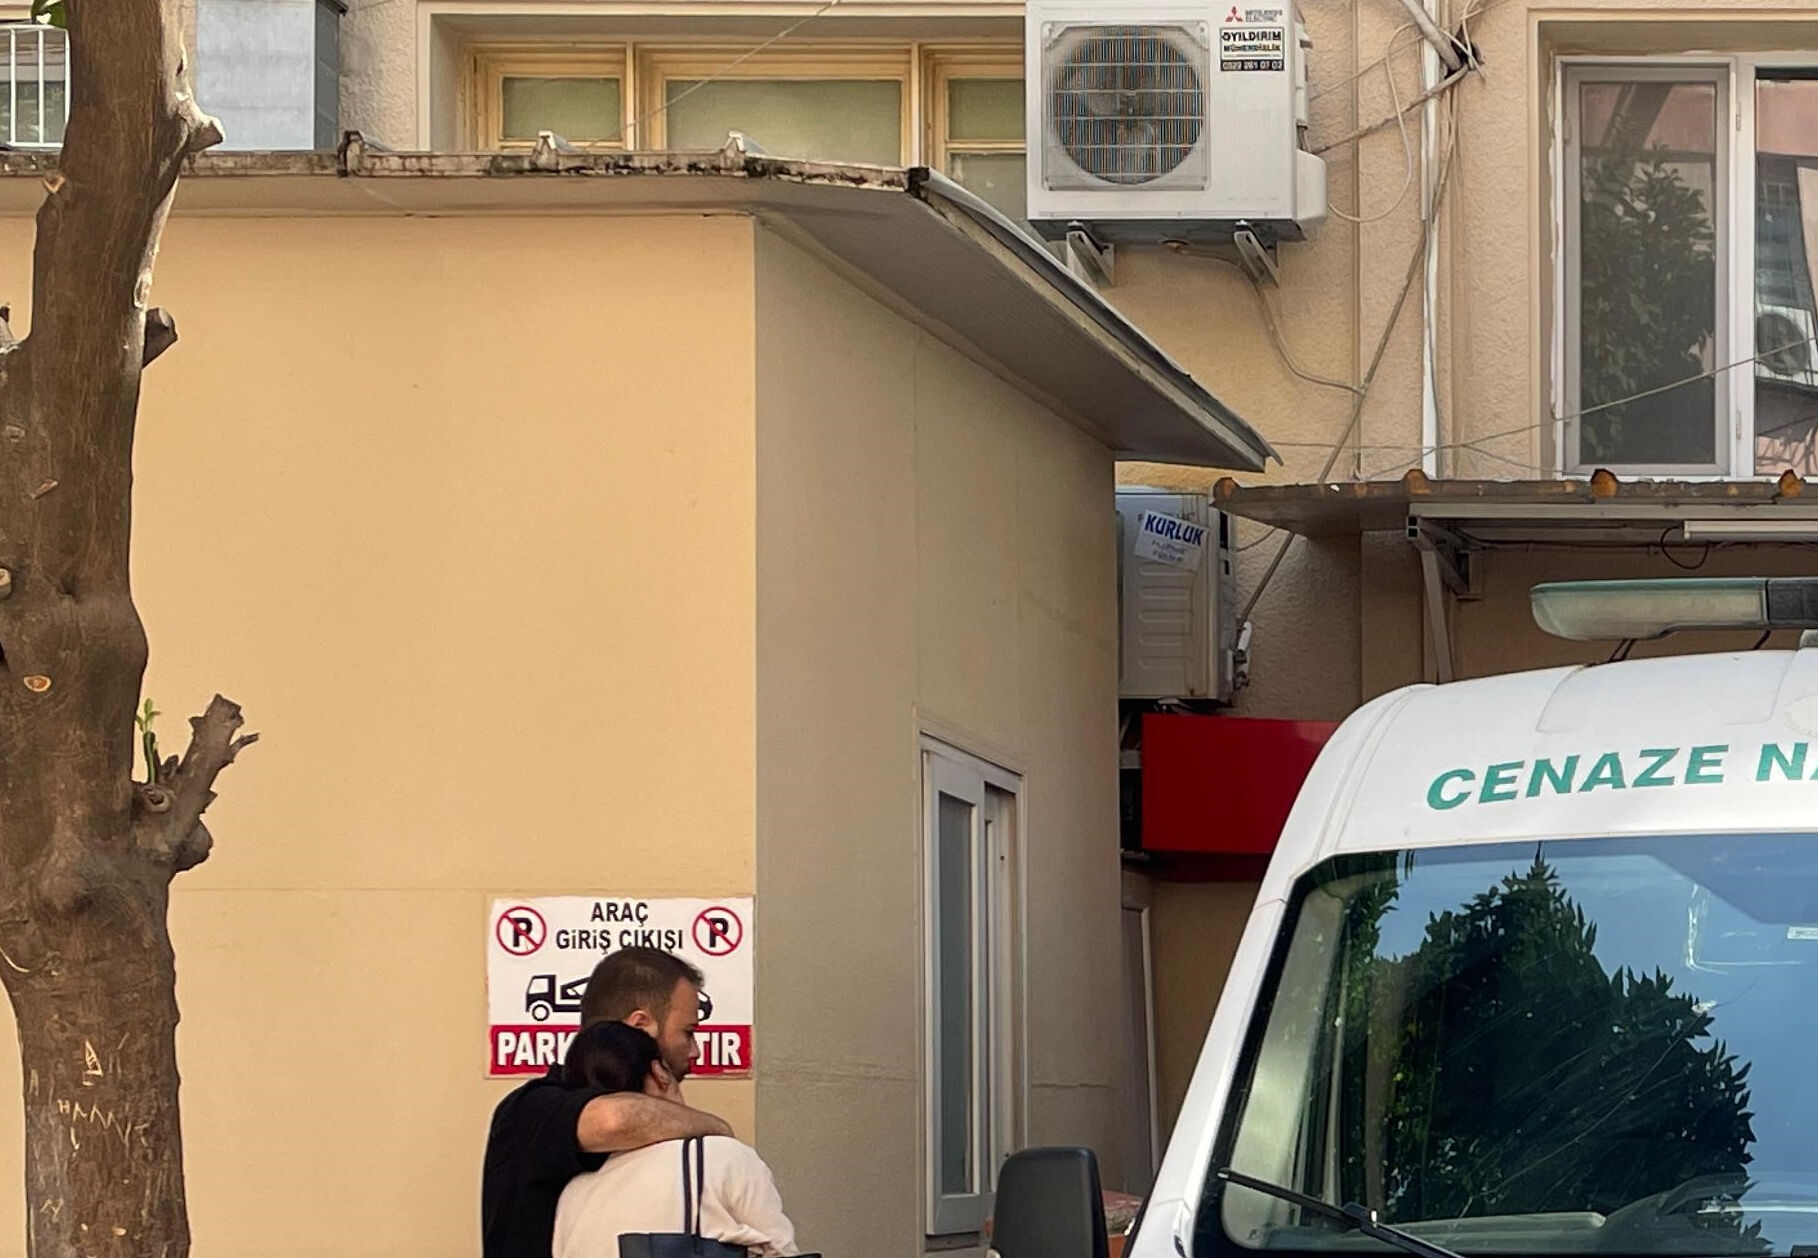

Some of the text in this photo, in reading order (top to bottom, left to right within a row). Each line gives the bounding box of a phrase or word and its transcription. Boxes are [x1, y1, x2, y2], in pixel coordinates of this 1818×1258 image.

[1145, 514, 1204, 546] KURLUK
[1427, 744, 1729, 811] CENAZE
[590, 902, 649, 928] ARAÇ
